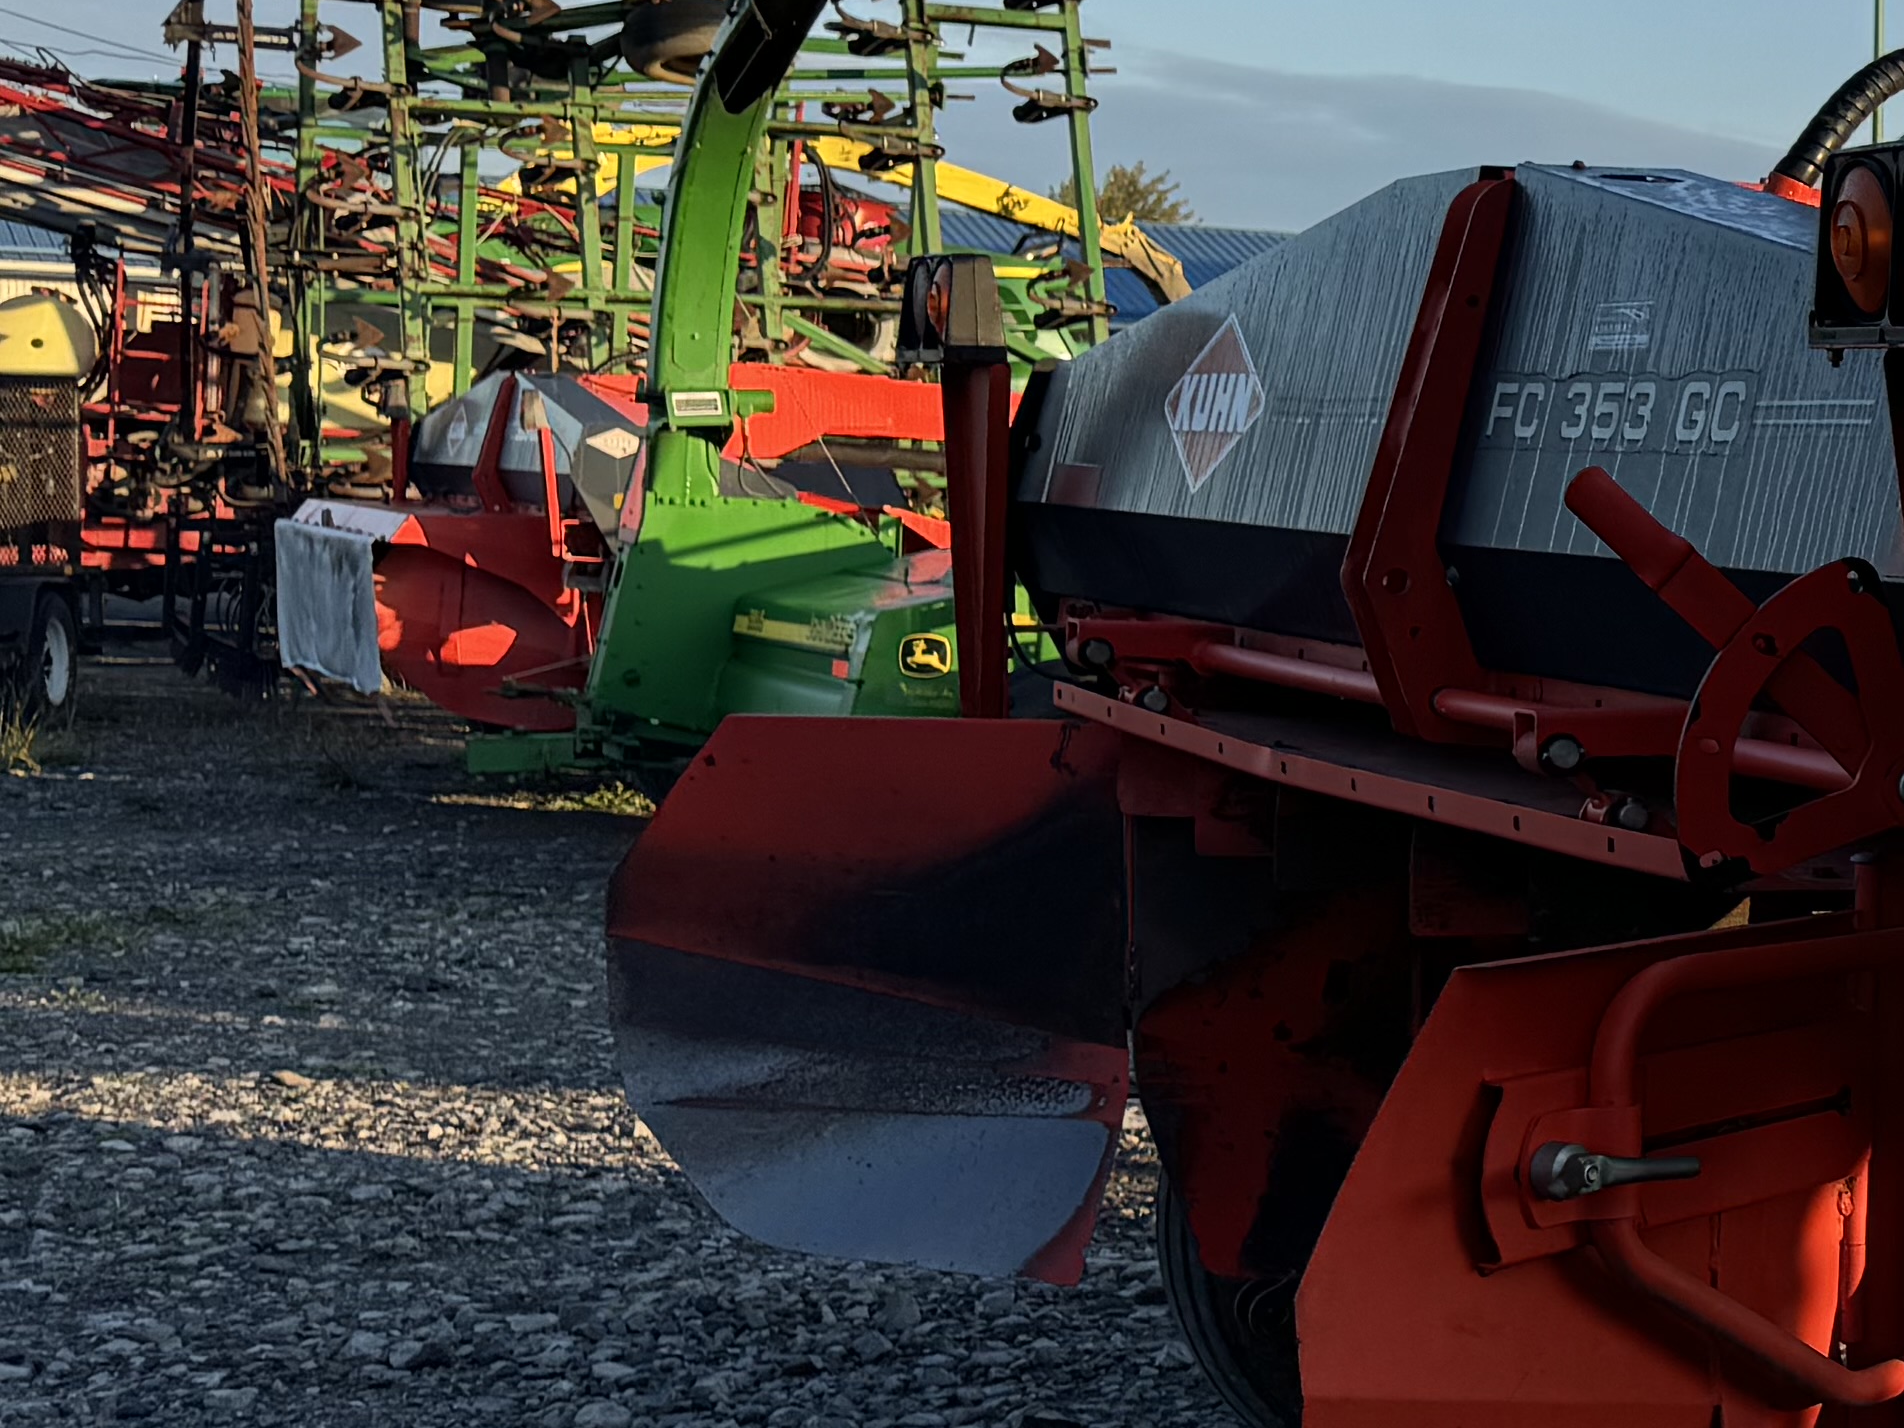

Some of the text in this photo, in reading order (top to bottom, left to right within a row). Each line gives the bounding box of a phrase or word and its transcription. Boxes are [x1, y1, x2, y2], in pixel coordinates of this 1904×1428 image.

[1174, 373, 1257, 433] KUHN
[1485, 380, 1747, 443] FC 353 GC
